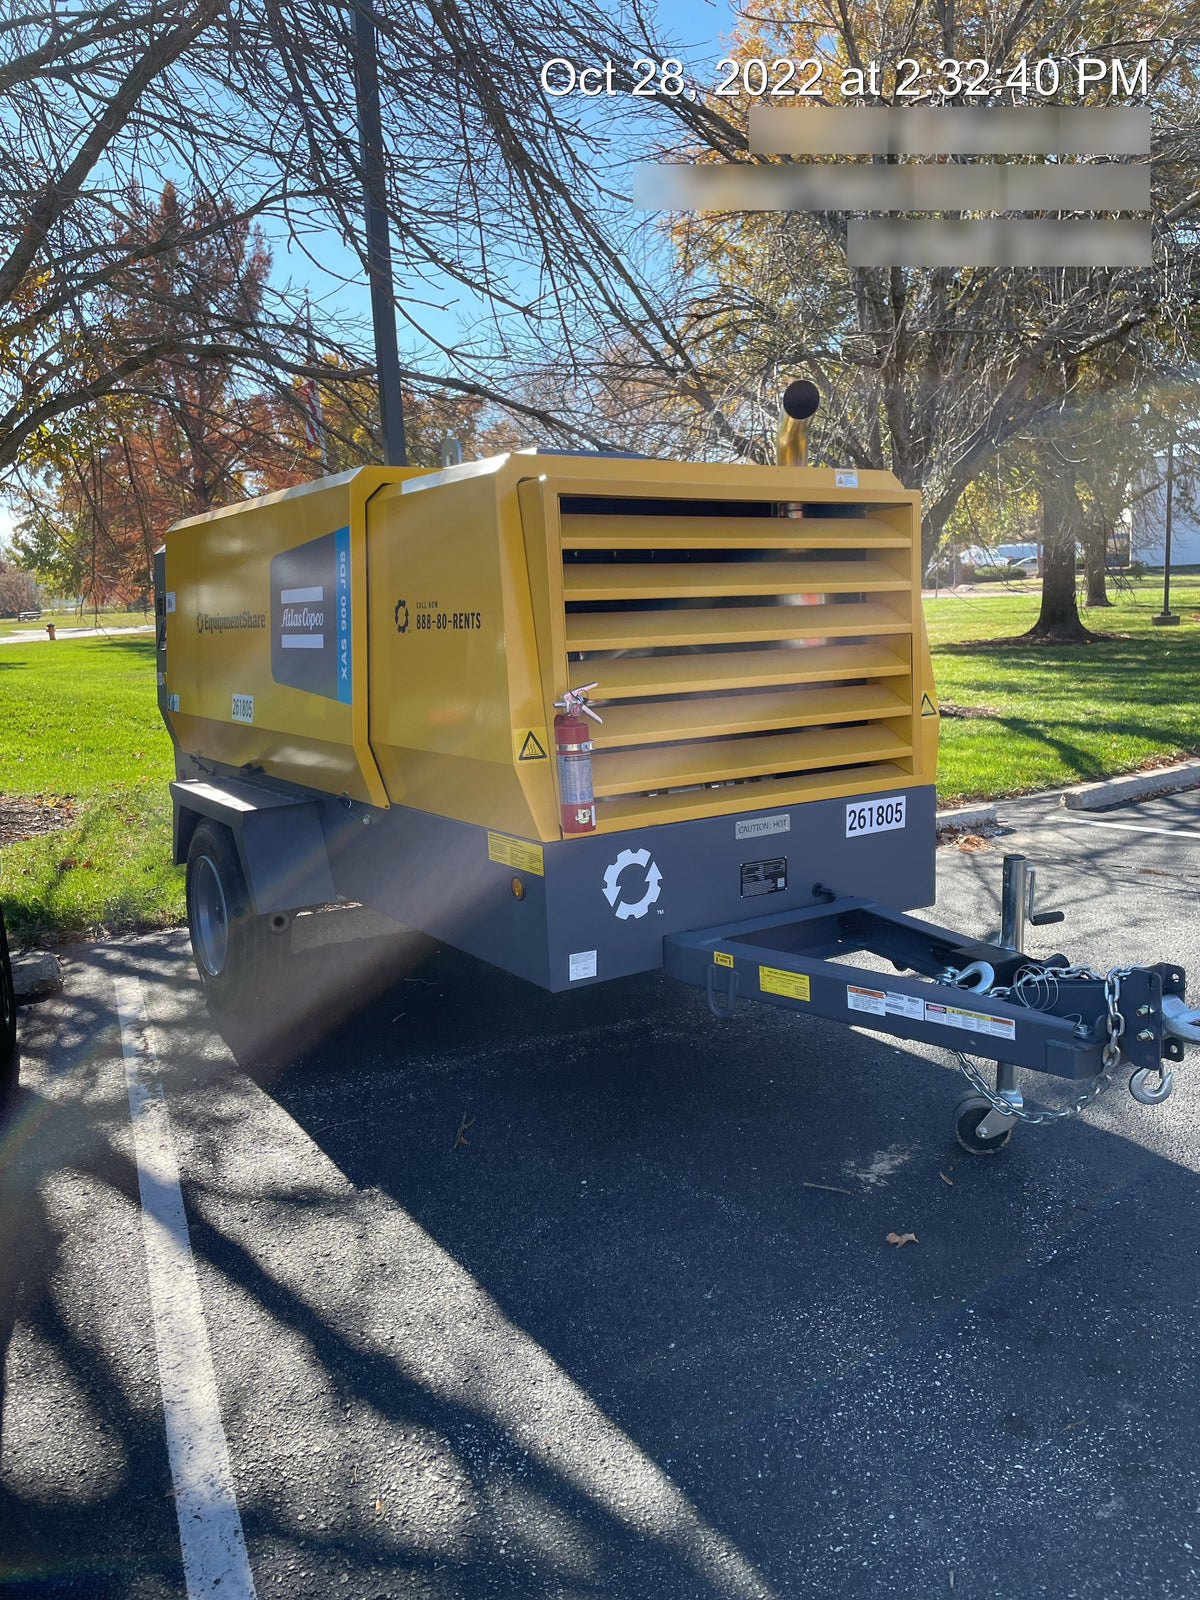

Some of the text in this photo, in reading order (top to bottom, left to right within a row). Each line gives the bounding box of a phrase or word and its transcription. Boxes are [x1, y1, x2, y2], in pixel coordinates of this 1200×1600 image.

[339, 551, 348, 681] XAS 900 JD8
[428, 601, 438, 609] NOW
[204, 610, 266, 634] EquipmentShare
[281, 606, 325, 631] Atlas Copco
[416, 612, 481, 630] 888-80-RENTS
[232, 698, 254, 720] 261805
[738, 818, 787, 835] CAUTION: HOT
[848, 802, 904, 832] 261805
